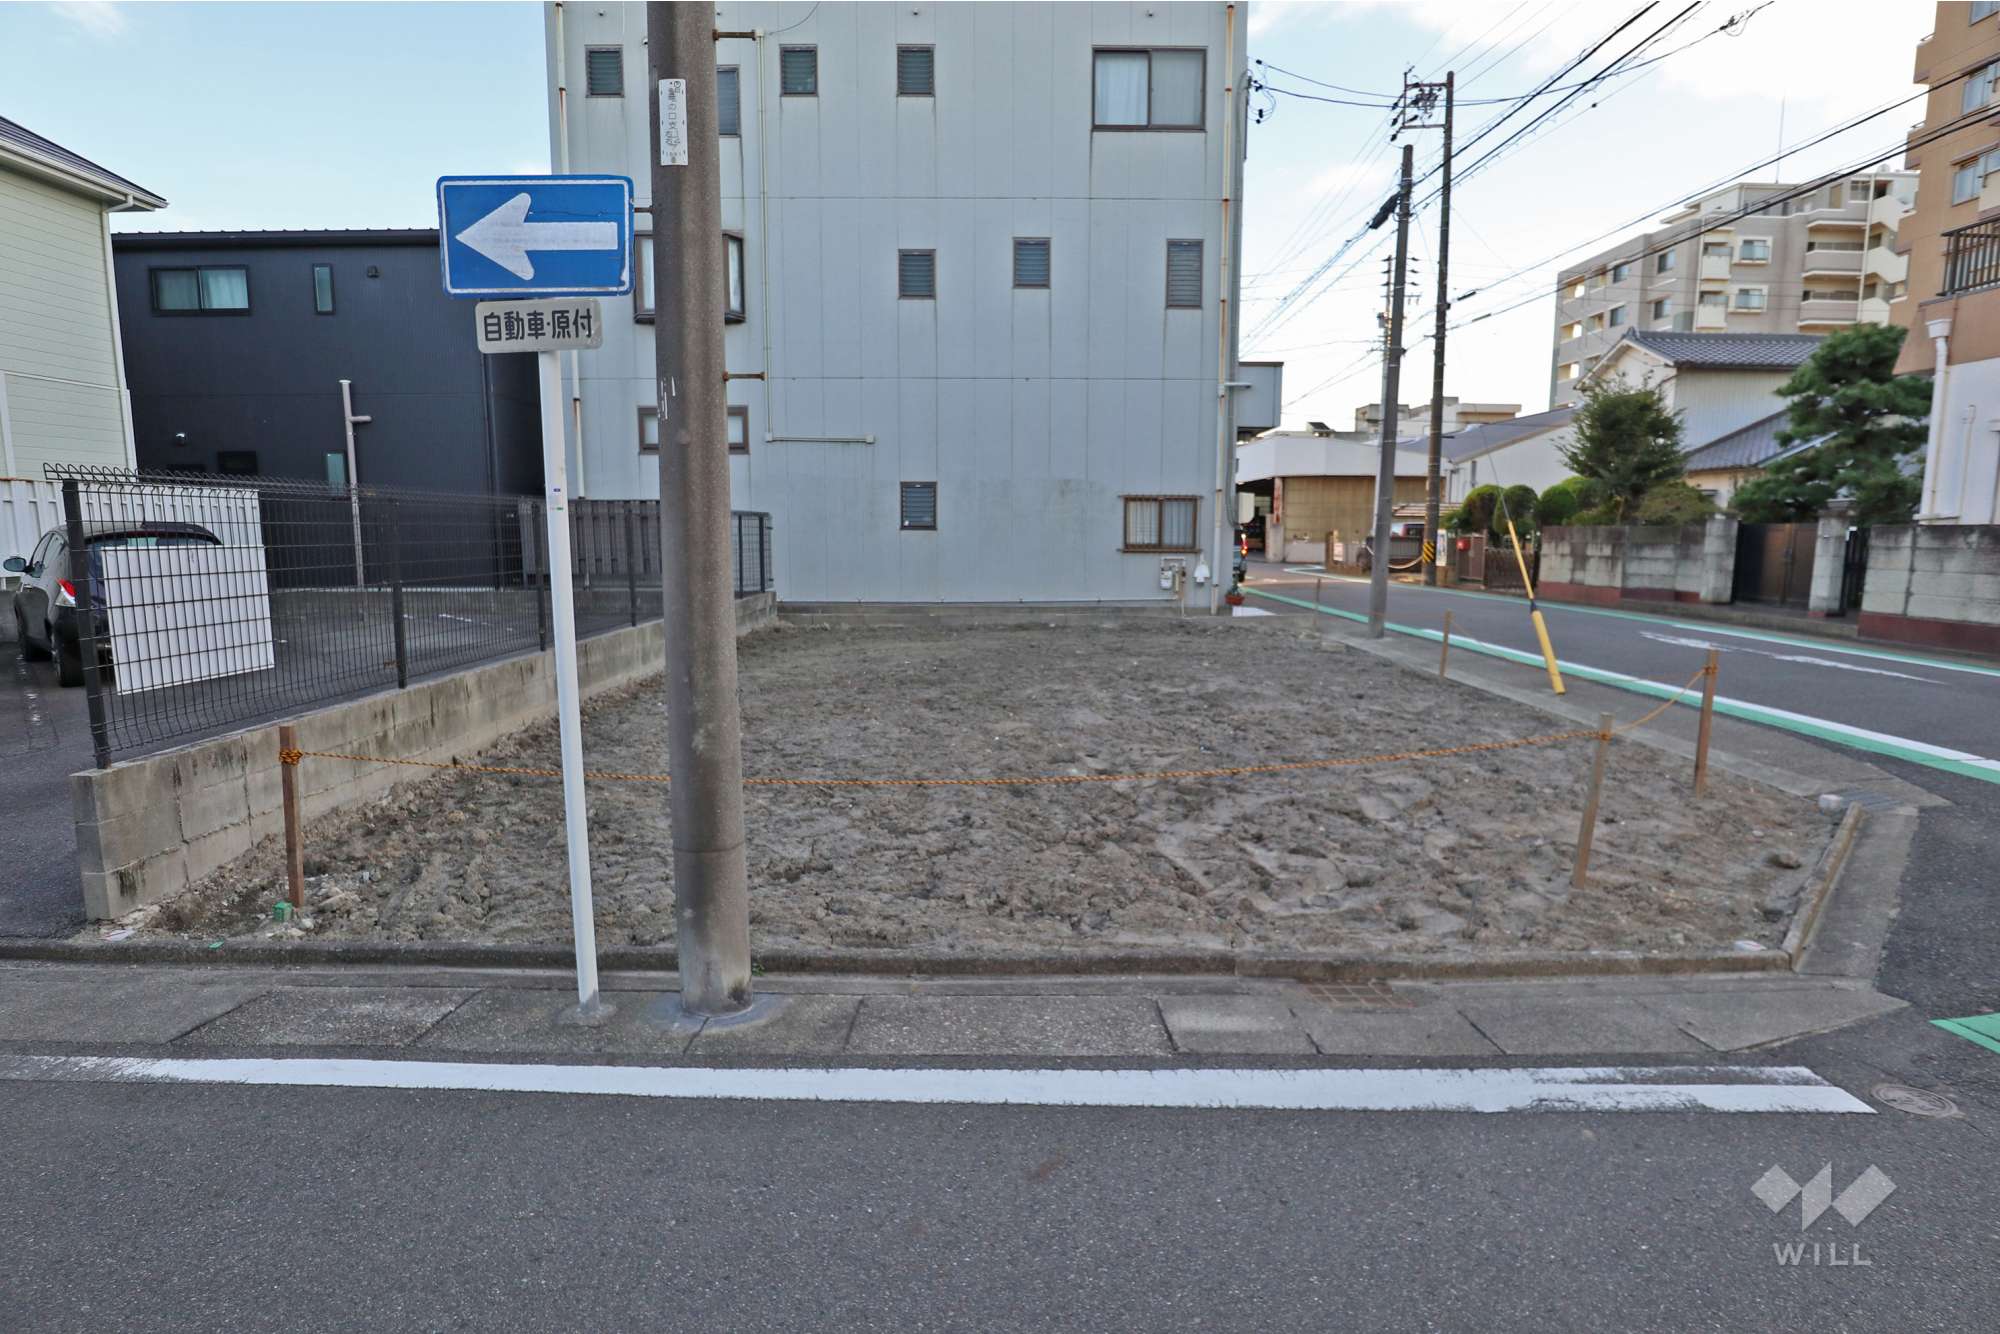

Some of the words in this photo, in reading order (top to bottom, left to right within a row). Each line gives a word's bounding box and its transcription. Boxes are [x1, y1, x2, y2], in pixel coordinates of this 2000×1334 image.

[483, 308, 592, 341] 自動車・原付
